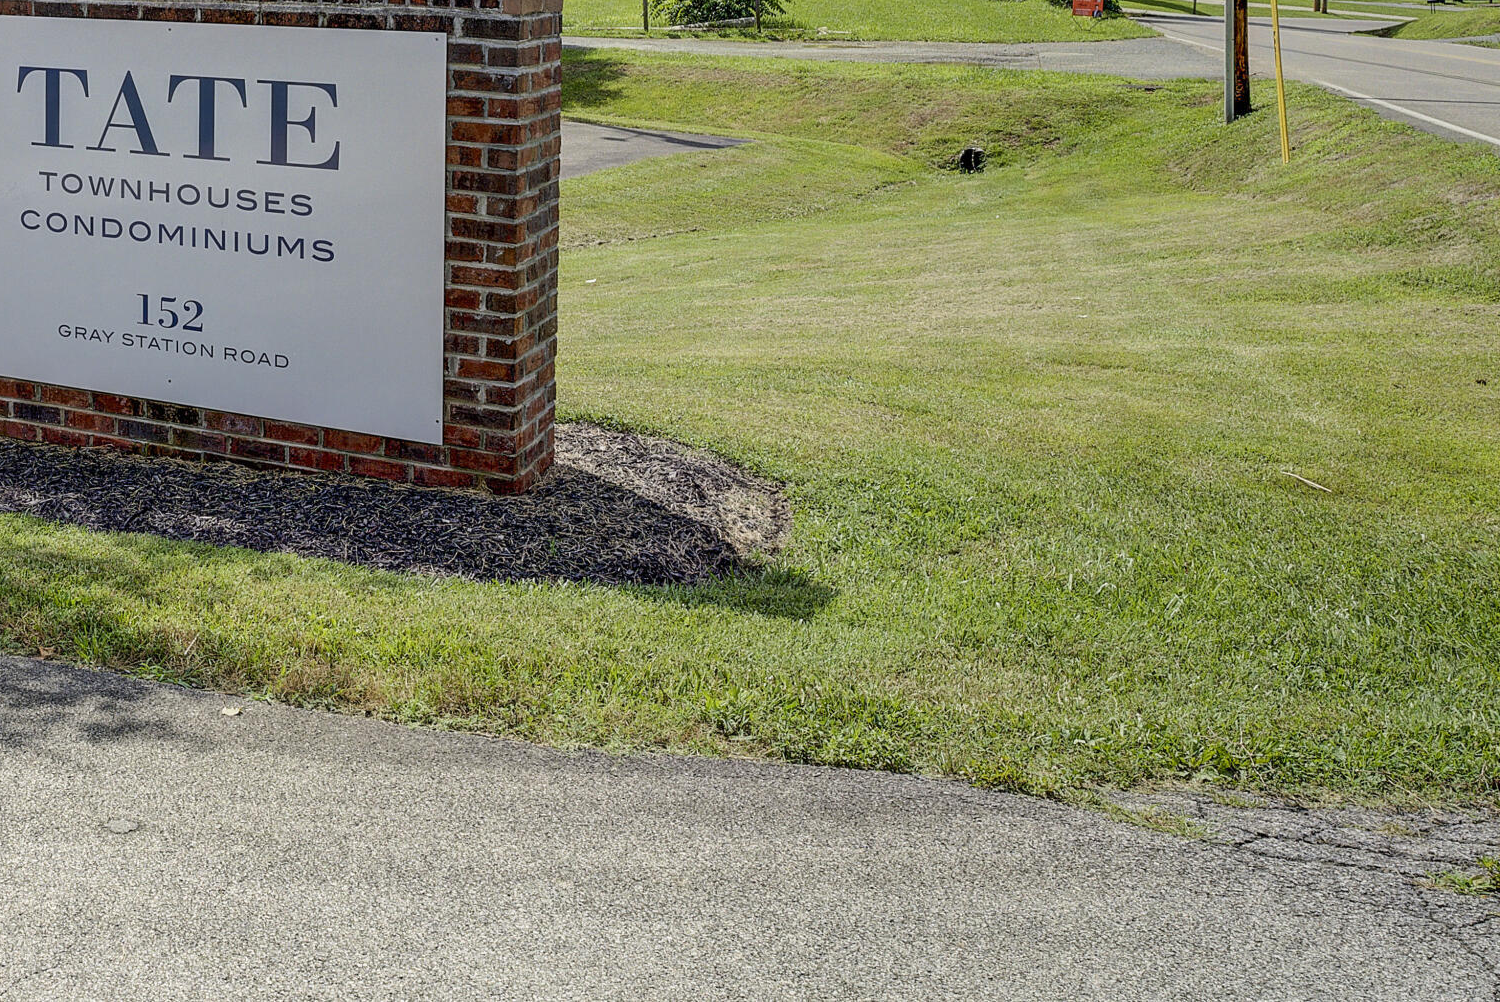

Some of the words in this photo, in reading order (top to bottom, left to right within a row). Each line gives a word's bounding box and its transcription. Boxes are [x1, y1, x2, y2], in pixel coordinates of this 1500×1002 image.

[16, 65, 341, 171] TATE
[38, 171, 313, 217] TOWNHOUSES
[20, 209, 335, 263] CONDOMINIUMS
[136, 293, 204, 333] 152
[58, 324, 115, 344] GRAY
[121, 332, 214, 359] STATION
[223, 346, 290, 369] ROAD
